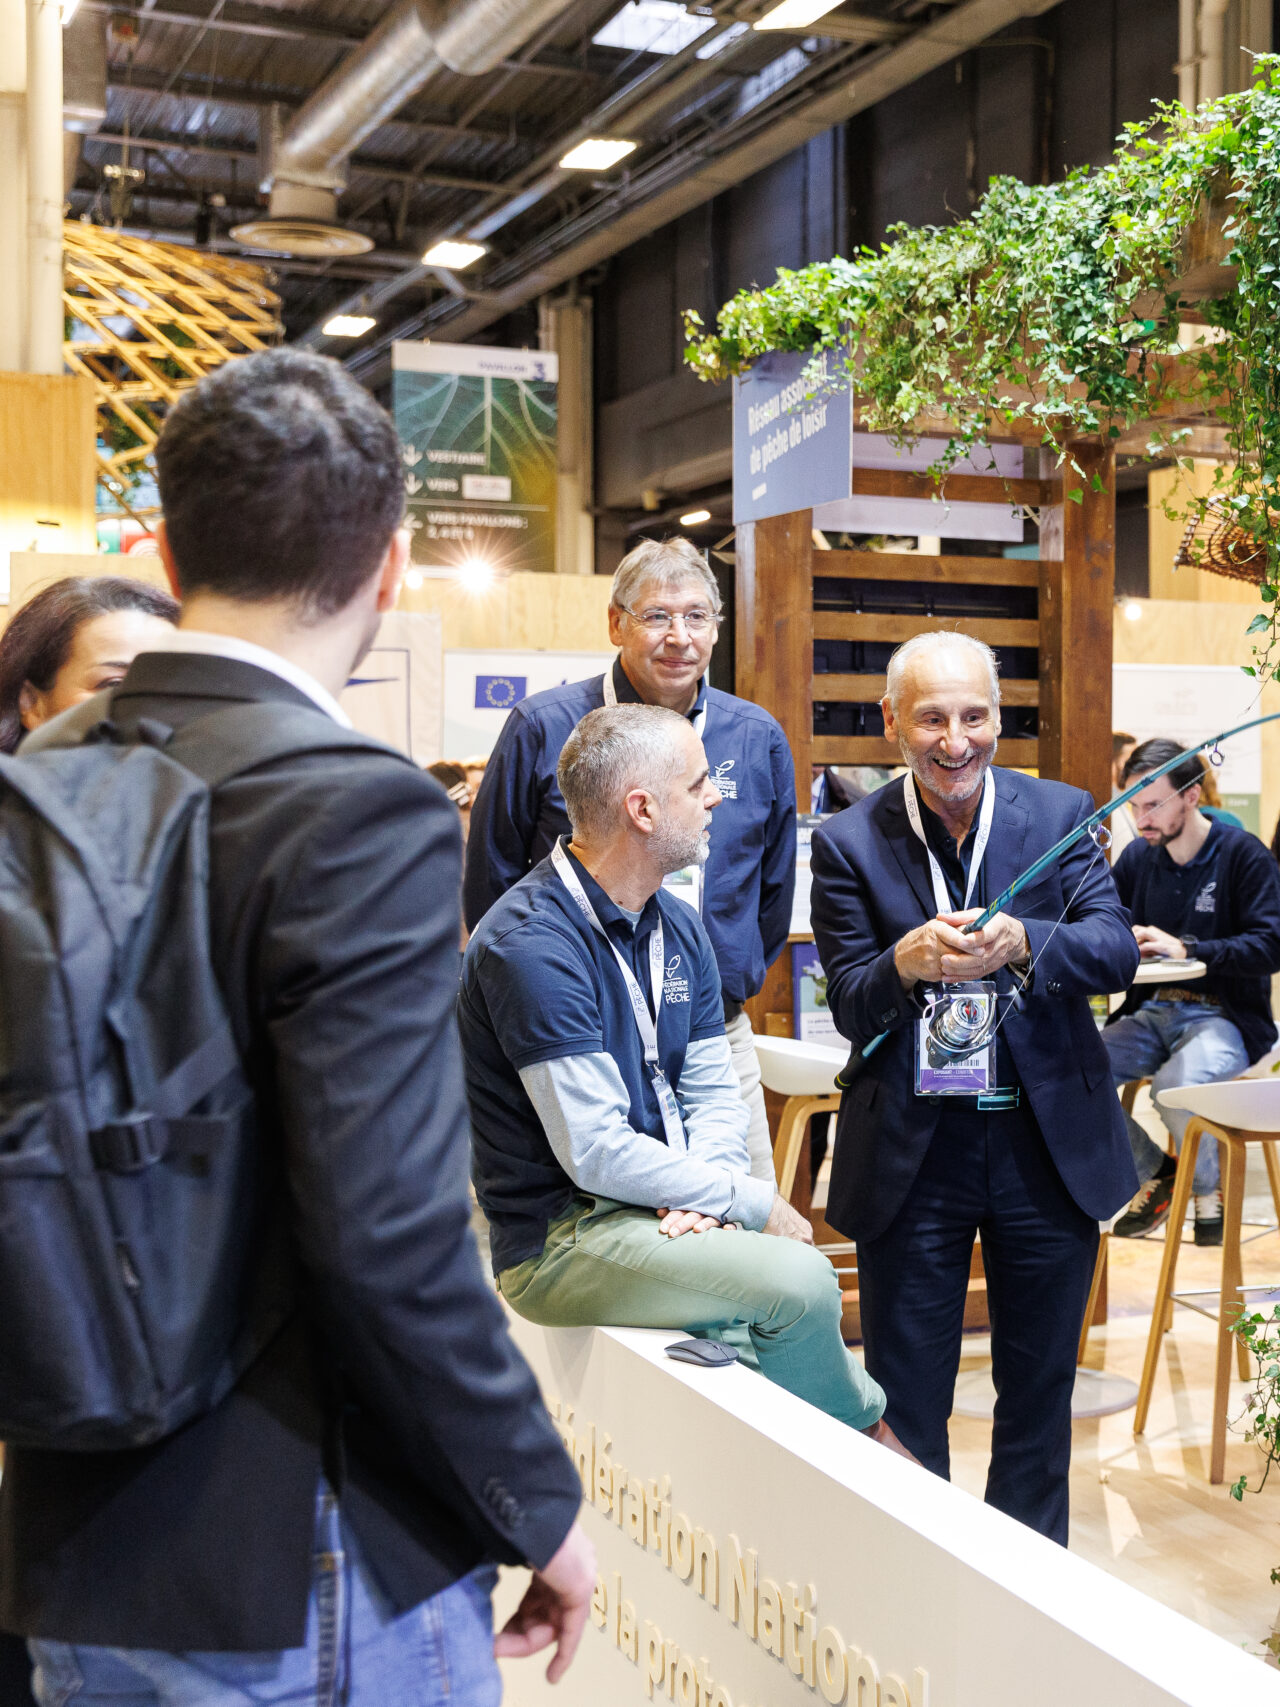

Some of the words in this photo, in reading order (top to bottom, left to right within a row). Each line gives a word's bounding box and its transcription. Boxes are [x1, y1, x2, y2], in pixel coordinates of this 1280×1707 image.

[533, 360, 547, 382] 3
[748, 394, 781, 437] Réseau
[780, 351, 829, 414] associf
[750, 445, 762, 476] de
[761, 427, 789, 474] pêche
[789, 416, 802, 449] de
[801, 399, 828, 441] loisir
[425, 477, 459, 493] VERS
[665, 992, 691, 1004] PÊCHE
[547, 1395, 720, 1605] dération
[613, 1571, 639, 1663] la
